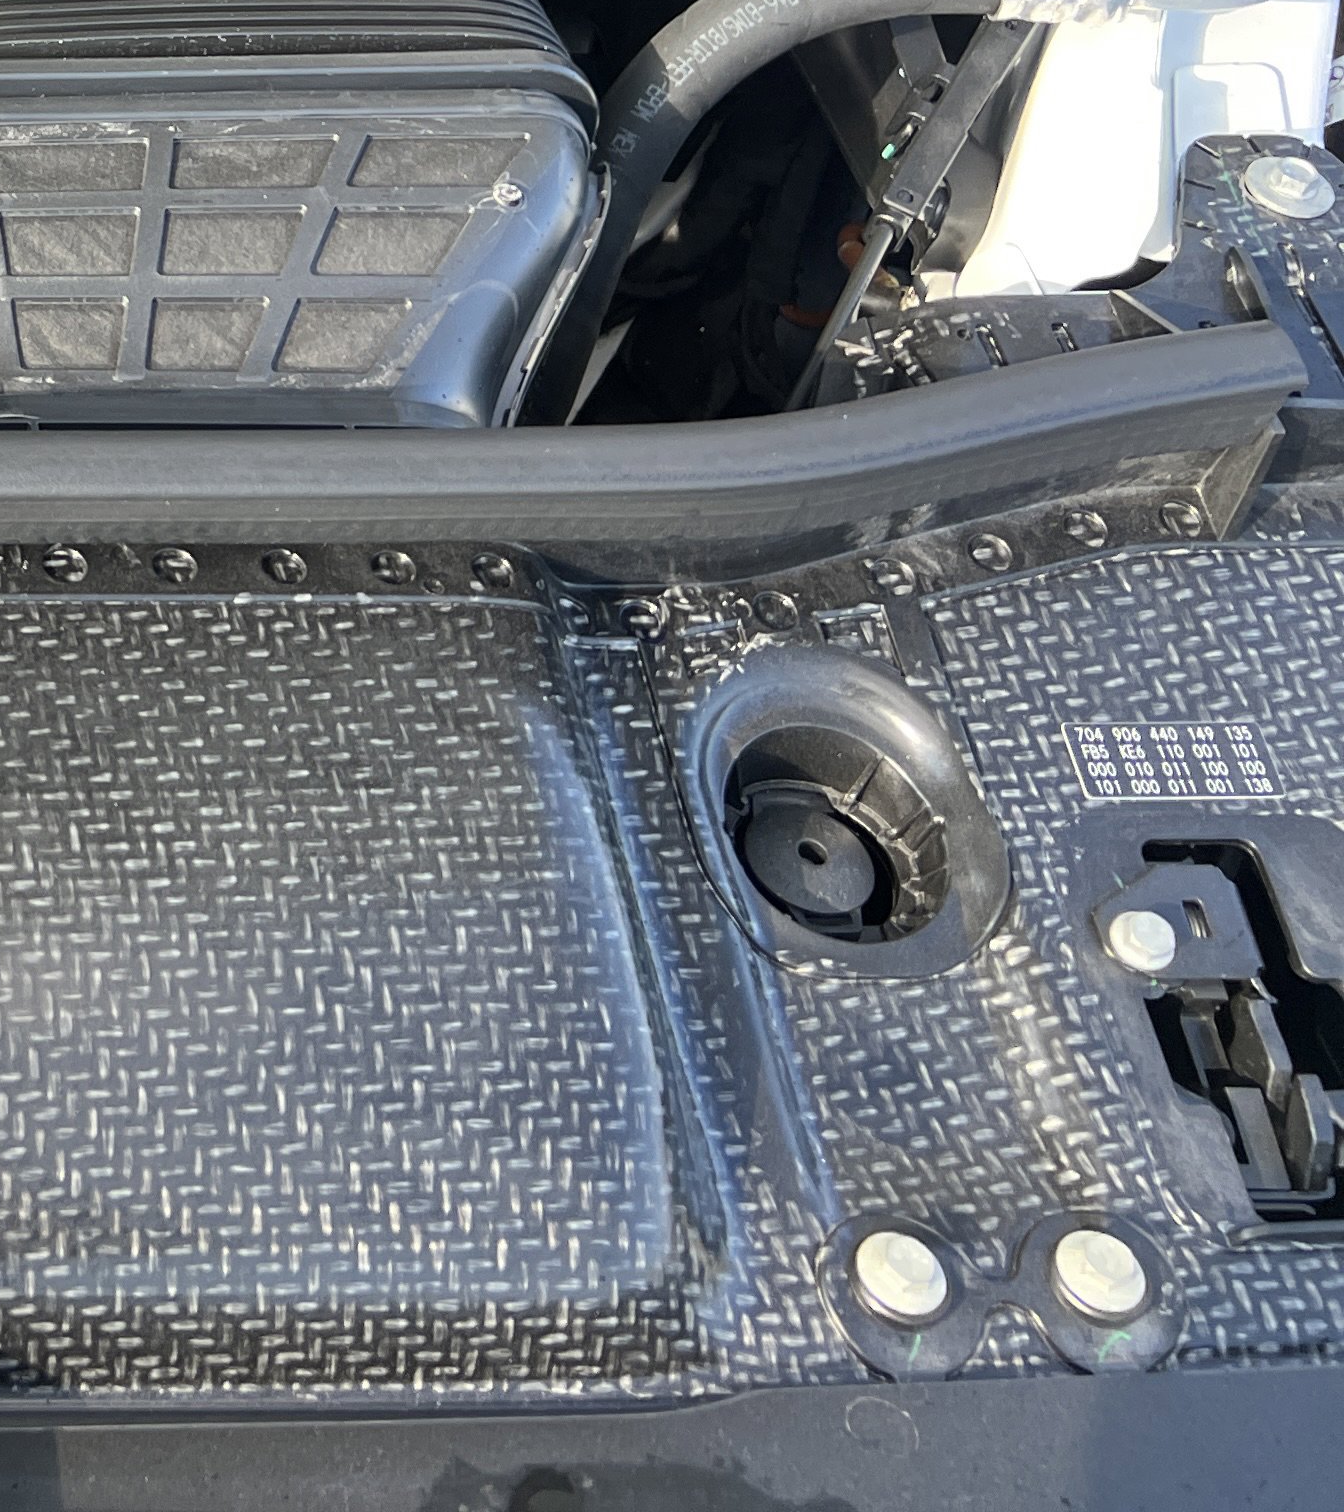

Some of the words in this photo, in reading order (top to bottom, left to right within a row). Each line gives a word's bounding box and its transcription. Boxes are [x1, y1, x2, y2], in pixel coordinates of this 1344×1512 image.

[1074, 726, 1104, 742] 704
[1112, 726, 1141, 742] 906
[1150, 726, 1178, 741] 440
[1187, 726, 1214, 741] 149
[1224, 725, 1253, 741] 135
[1080, 744, 1110, 760] FB5
[1118, 744, 1146, 760] KE6
[1156, 744, 1185, 759] 110
[1192, 744, 1221, 759] 001
[1231, 743, 1259, 758] 101
[1087, 762, 1117, 777] 000
[1124, 761, 1155, 777] 010
[1161, 761, 1191, 777] 011
[1200, 761, 1229, 777] 100
[1237, 760, 1266, 776] 100
[1094, 779, 1122, 795] 101
[1130, 779, 1161, 795] 000
[1167, 779, 1198, 794] 011
[1205, 778, 1235, 794] 001
[1244, 777, 1274, 793] 138
